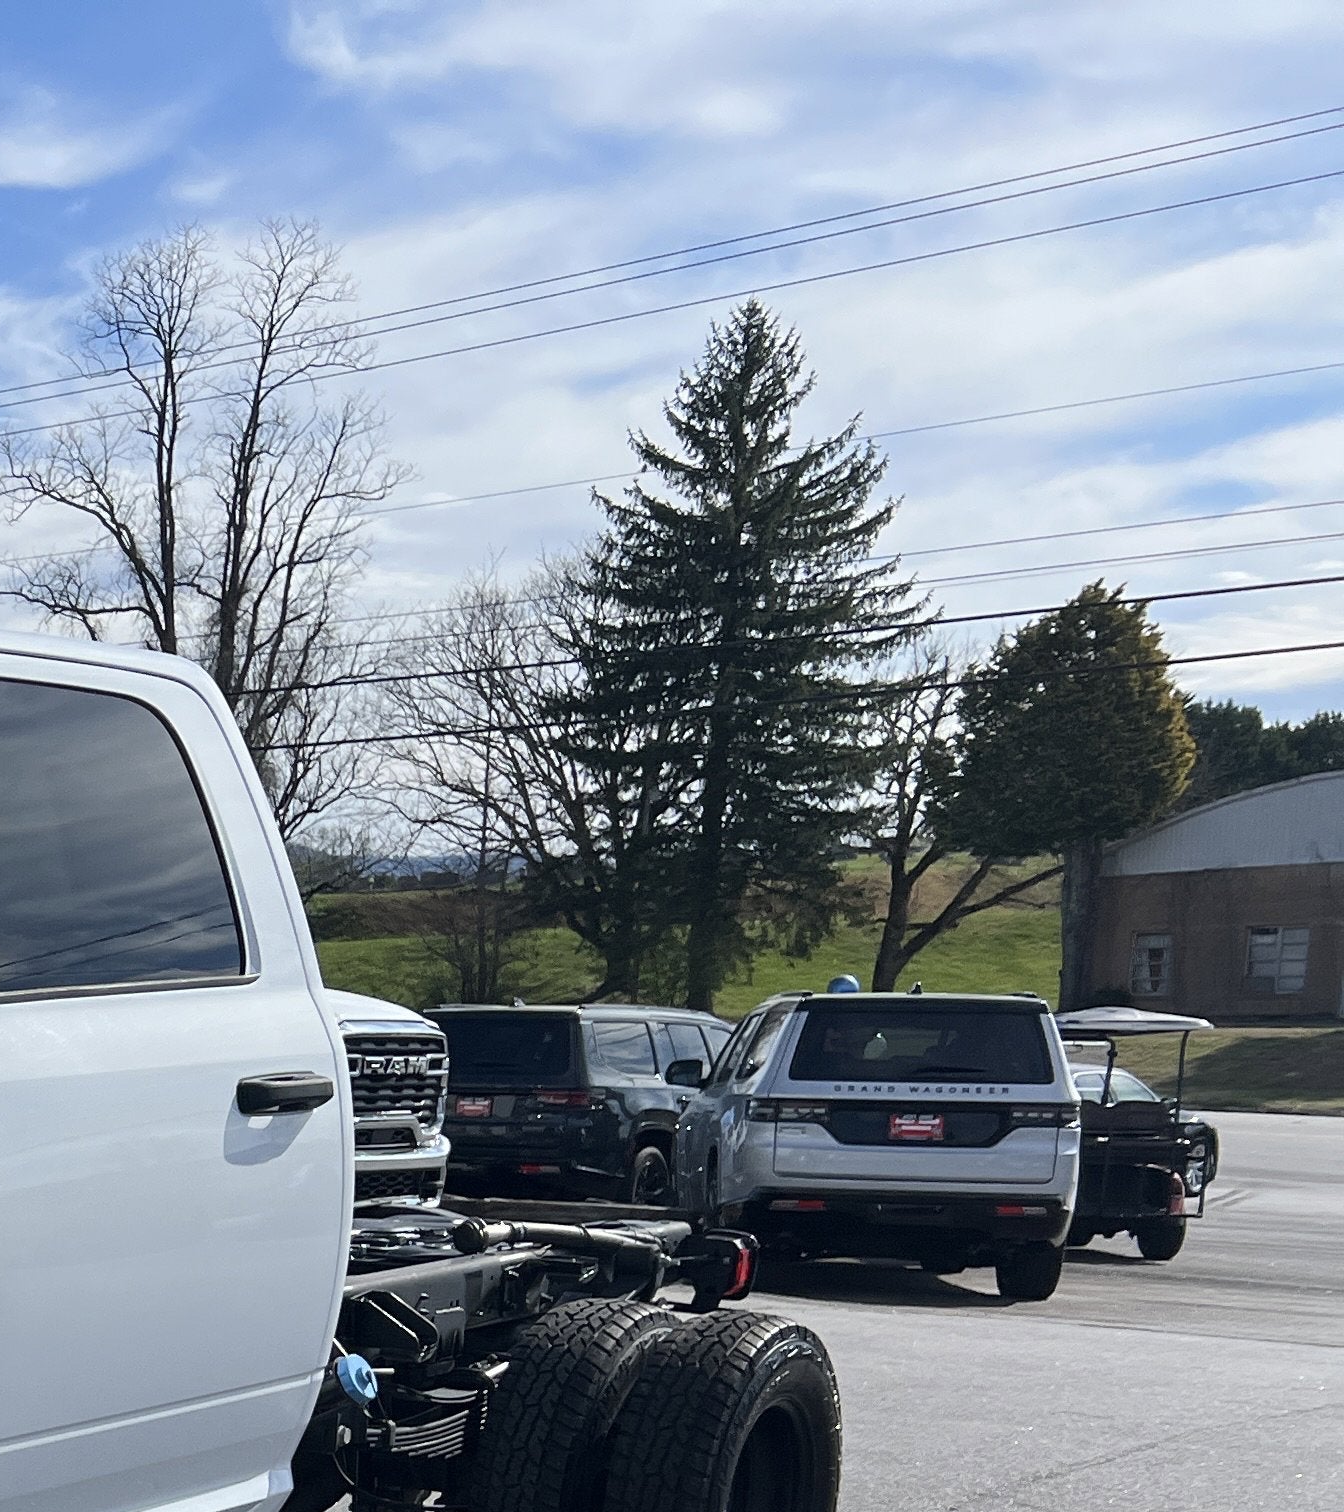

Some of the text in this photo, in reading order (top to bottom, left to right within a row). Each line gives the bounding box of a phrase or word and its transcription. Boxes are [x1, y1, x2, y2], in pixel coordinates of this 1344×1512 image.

[363, 1056, 427, 1075] RAM
[834, 1085, 1010, 1095] GRAND WAGONEER
